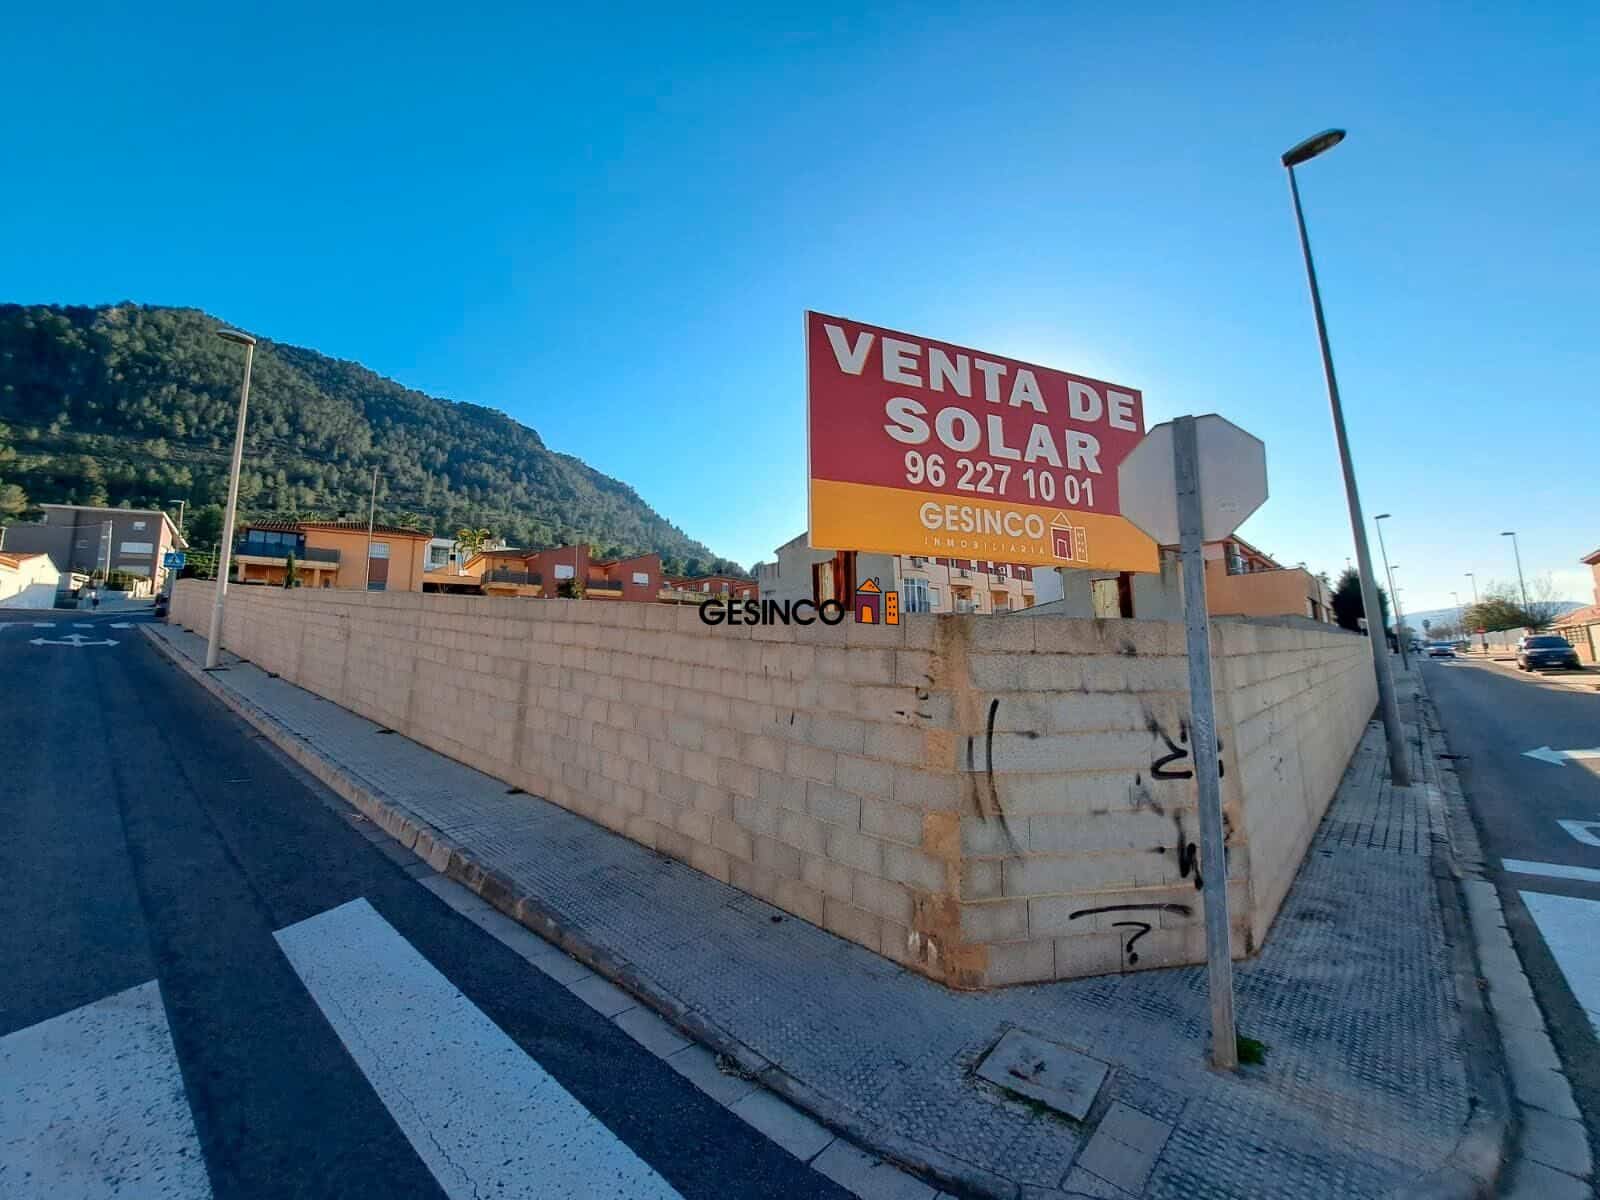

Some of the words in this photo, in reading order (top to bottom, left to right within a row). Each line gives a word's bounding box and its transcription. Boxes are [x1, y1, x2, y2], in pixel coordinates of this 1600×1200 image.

[824, 323, 1047, 414] VENTA
[1068, 380, 1137, 432] DE
[885, 397, 1103, 474] SOLAR
[905, 451, 946, 487] 96
[956, 458, 1011, 495] 227
[1023, 468, 1056, 502] 10
[1065, 474, 1094, 507] 01
[919, 502, 1045, 539] GESINCO
[924, 536, 1046, 555] INMOBILIARIA
